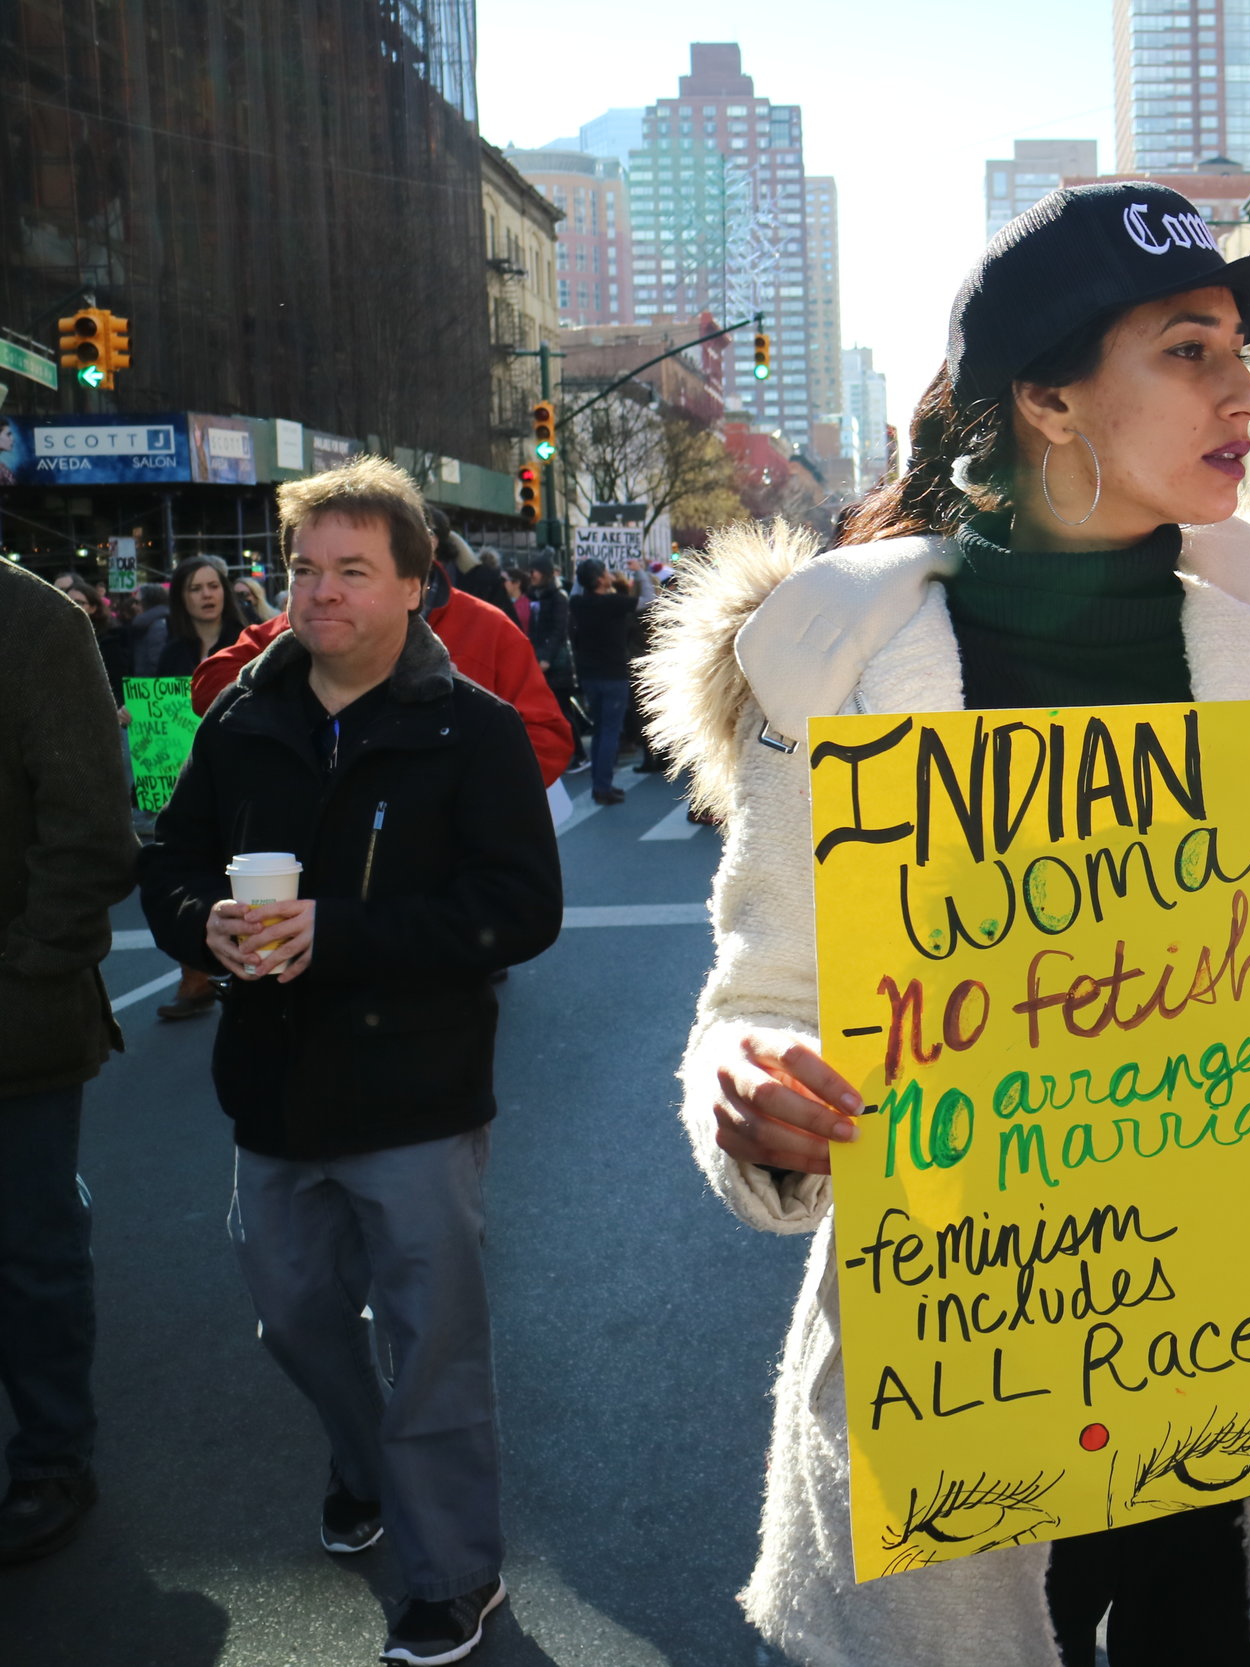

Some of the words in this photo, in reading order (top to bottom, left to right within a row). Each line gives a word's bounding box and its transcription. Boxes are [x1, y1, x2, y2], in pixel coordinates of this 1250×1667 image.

[1123, 203, 1217, 255] Com
[43, 433, 138, 449] SCOTT
[152, 432, 165, 448] J
[37, 457, 93, 470] AVEDA
[132, 456, 176, 468] SALON
[577, 530, 598, 544] WE
[601, 531, 621, 544] ARE
[623, 532, 641, 545] THE
[576, 545, 643, 559] DAUGHTERS
[123, 679, 150, 699] THIS
[153, 679, 192, 700] COUNTR
[147, 701, 163, 718] IS
[135, 776, 157, 791] AND
[811, 709, 1206, 866] INDIAN
[137, 791, 172, 811] BEA
[916, 1257, 1177, 1343] includes
[870, 1348, 1051, 1430] ALL
